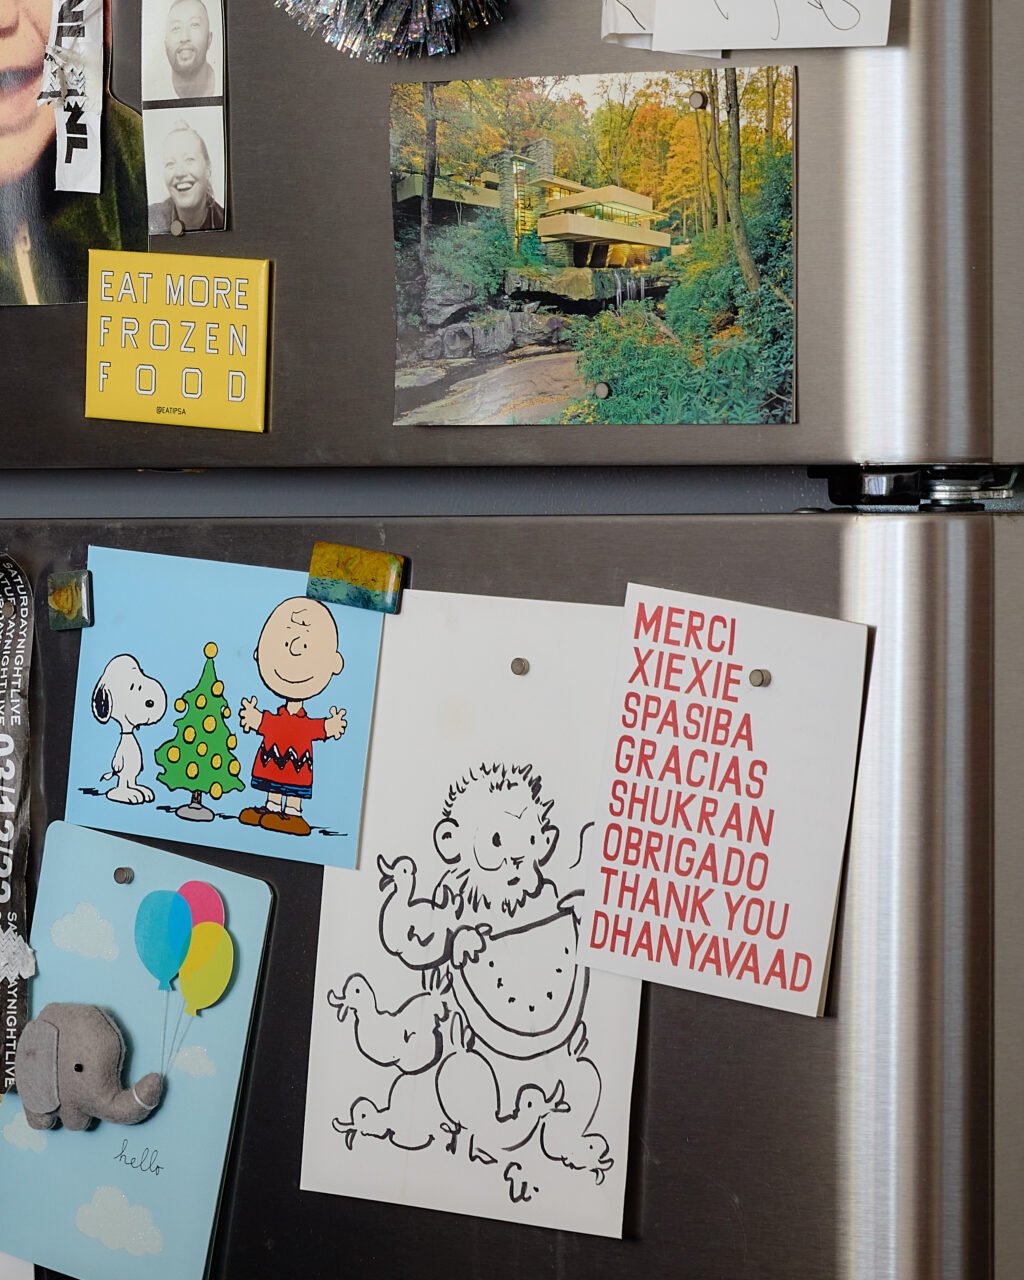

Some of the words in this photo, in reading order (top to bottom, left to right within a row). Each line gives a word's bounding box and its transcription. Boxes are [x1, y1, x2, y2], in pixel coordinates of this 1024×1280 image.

[100, 270, 153, 304] EAT
[165, 273, 249, 310] MORE
[99, 315, 247, 356] FROZEN
[98, 361, 247, 402] FOOD
[633, 602, 737, 656] MERCI
[628, 647, 743, 703] XIEXIE
[621, 692, 753, 751] SPASIBA
[615, 735, 768, 799] GRACIAS
[609, 779, 775, 846] SHUKRAN
[602, 822, 769, 891] OBRIGADO
[600, 867, 712, 927] THANK
[724, 892, 790, 940] YOU
[589, 909, 813, 992] DHANYAVAAD
[114, 1139, 165, 1176] hello
